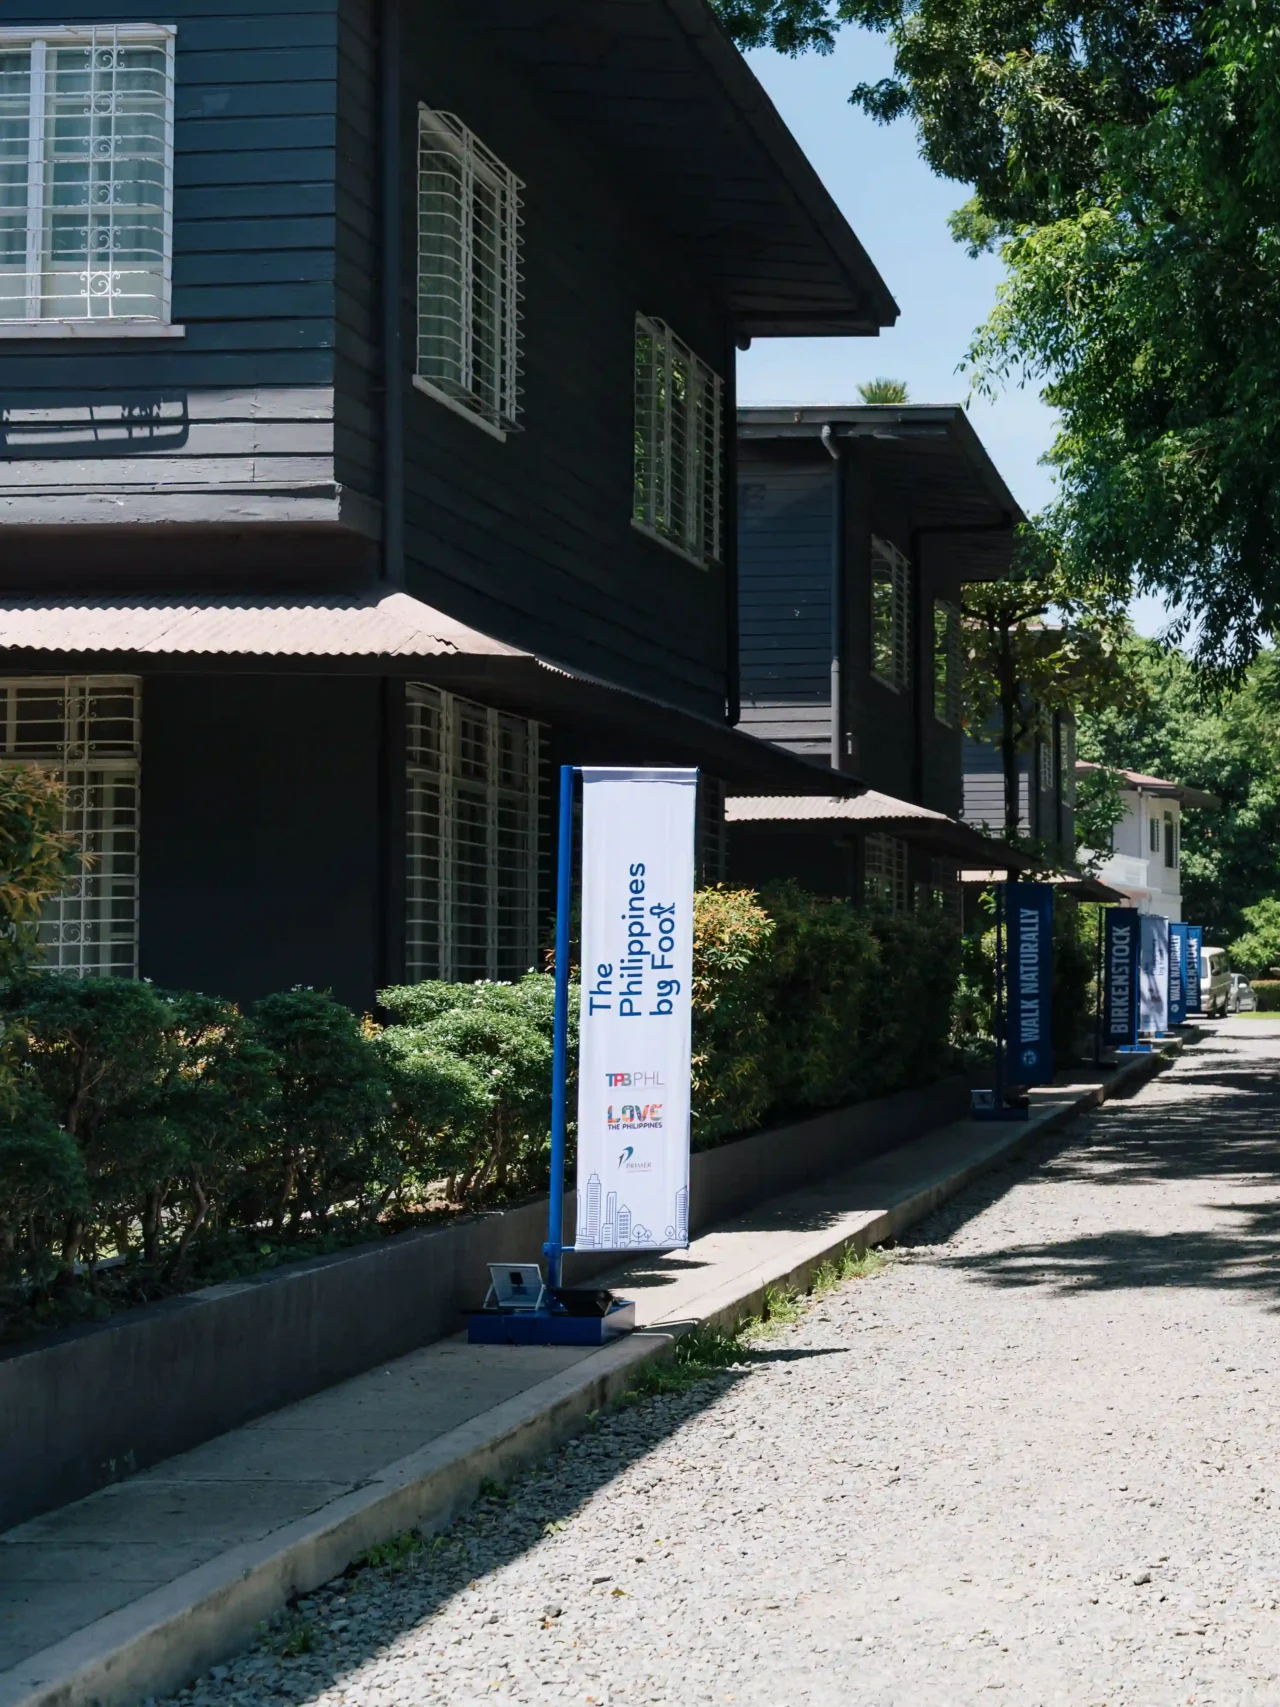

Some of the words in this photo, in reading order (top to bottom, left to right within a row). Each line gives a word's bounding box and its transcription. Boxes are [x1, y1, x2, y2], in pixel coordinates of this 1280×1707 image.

[619, 862, 651, 1017] Philippines
[649, 902, 676, 970] Foot
[1019, 907, 1040, 990] NATURALLY
[1170, 934, 1181, 978] NATURALLY
[589, 963, 613, 1016] The
[649, 979, 681, 1016] by
[1110, 925, 1131, 1034] BIRKENSTOCK
[1170, 979, 1181, 1001] WALK
[1186, 938, 1198, 1006] BIRKENSTOCK
[1020, 991, 1040, 1043] WALK
[607, 1104, 663, 1123] LOVE
[622, 1122, 663, 1130] PHILIPPINES
